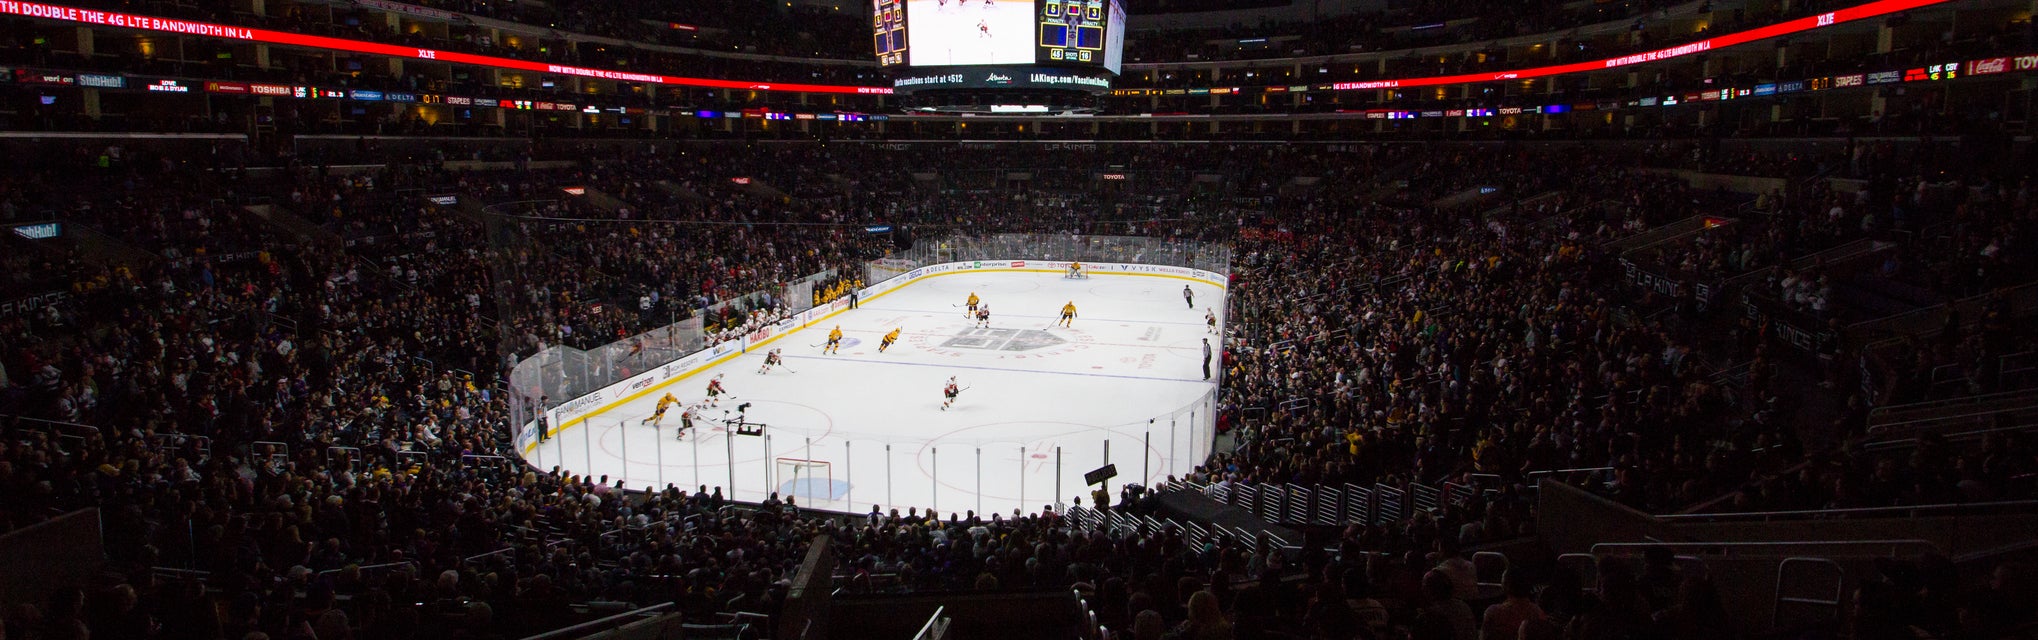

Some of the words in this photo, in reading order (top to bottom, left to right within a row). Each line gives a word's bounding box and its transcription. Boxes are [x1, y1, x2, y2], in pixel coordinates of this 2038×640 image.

[23, 3, 77, 21] DOUBLE
[80, 10, 105, 24] THE
[108, 14, 125, 26] 4G
[128, 16, 150, 29] LTE
[153, 19, 222, 37] BANDWIDTH
[225, 27, 236, 37] IN
[239, 29, 253, 39] LA
[1817, 13, 1835, 27] XLTE
[418, 49, 435, 59] XLTE
[1628, 53, 1647, 64] DOUBLE
[1647, 50, 1656, 61] THE
[1929, 65, 1942, 73] LAK
[80, 75, 122, 87] StubHub!
[924, 75, 938, 84] start
[940, 75, 946, 83] at
[948, 74, 963, 83] $512
[1835, 75, 1862, 87] STAPLES
[251, 85, 291, 95] TOSHIBA
[447, 96, 470, 105] STAPLES
[931, 264, 949, 272] DELTA
[632, 376, 654, 390] verizon
[574, 392, 602, 408] MANUEL
